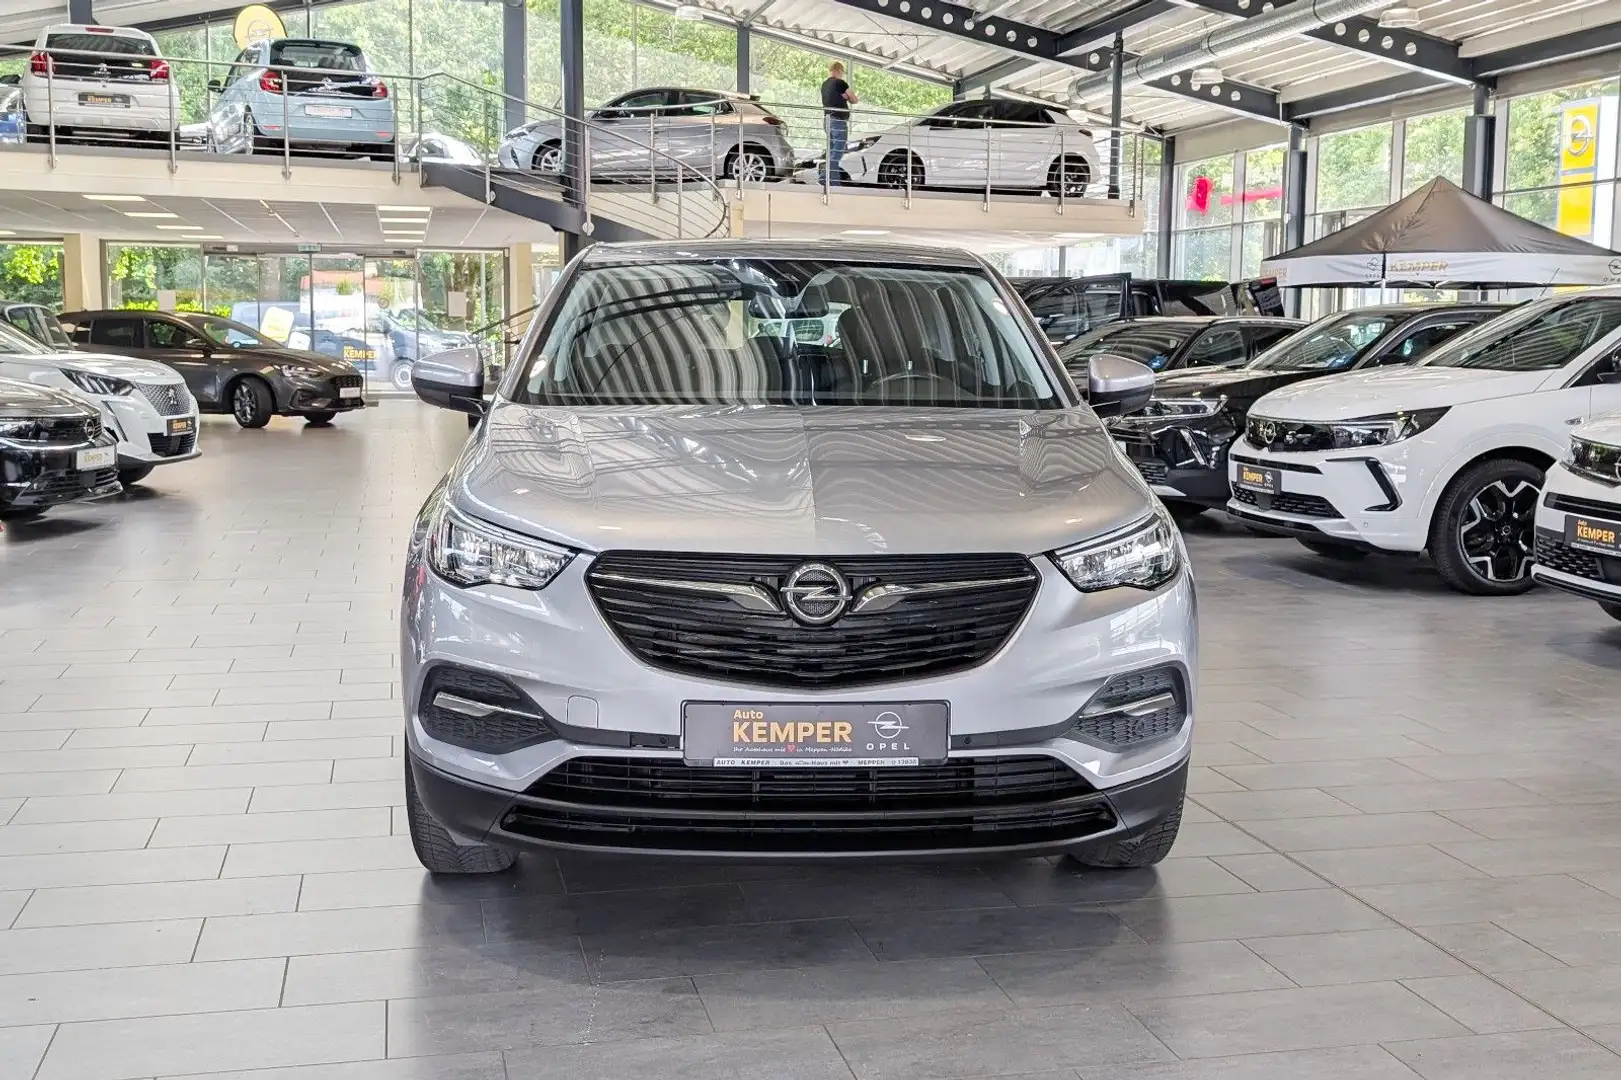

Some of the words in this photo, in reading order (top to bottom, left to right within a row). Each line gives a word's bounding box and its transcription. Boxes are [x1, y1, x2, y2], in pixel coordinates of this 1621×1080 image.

[1577, 525, 1615, 543] KEMPER
[733, 709, 764, 720] Auto
[733, 721, 853, 743] KEMPER
[866, 742, 911, 751] OPEL
